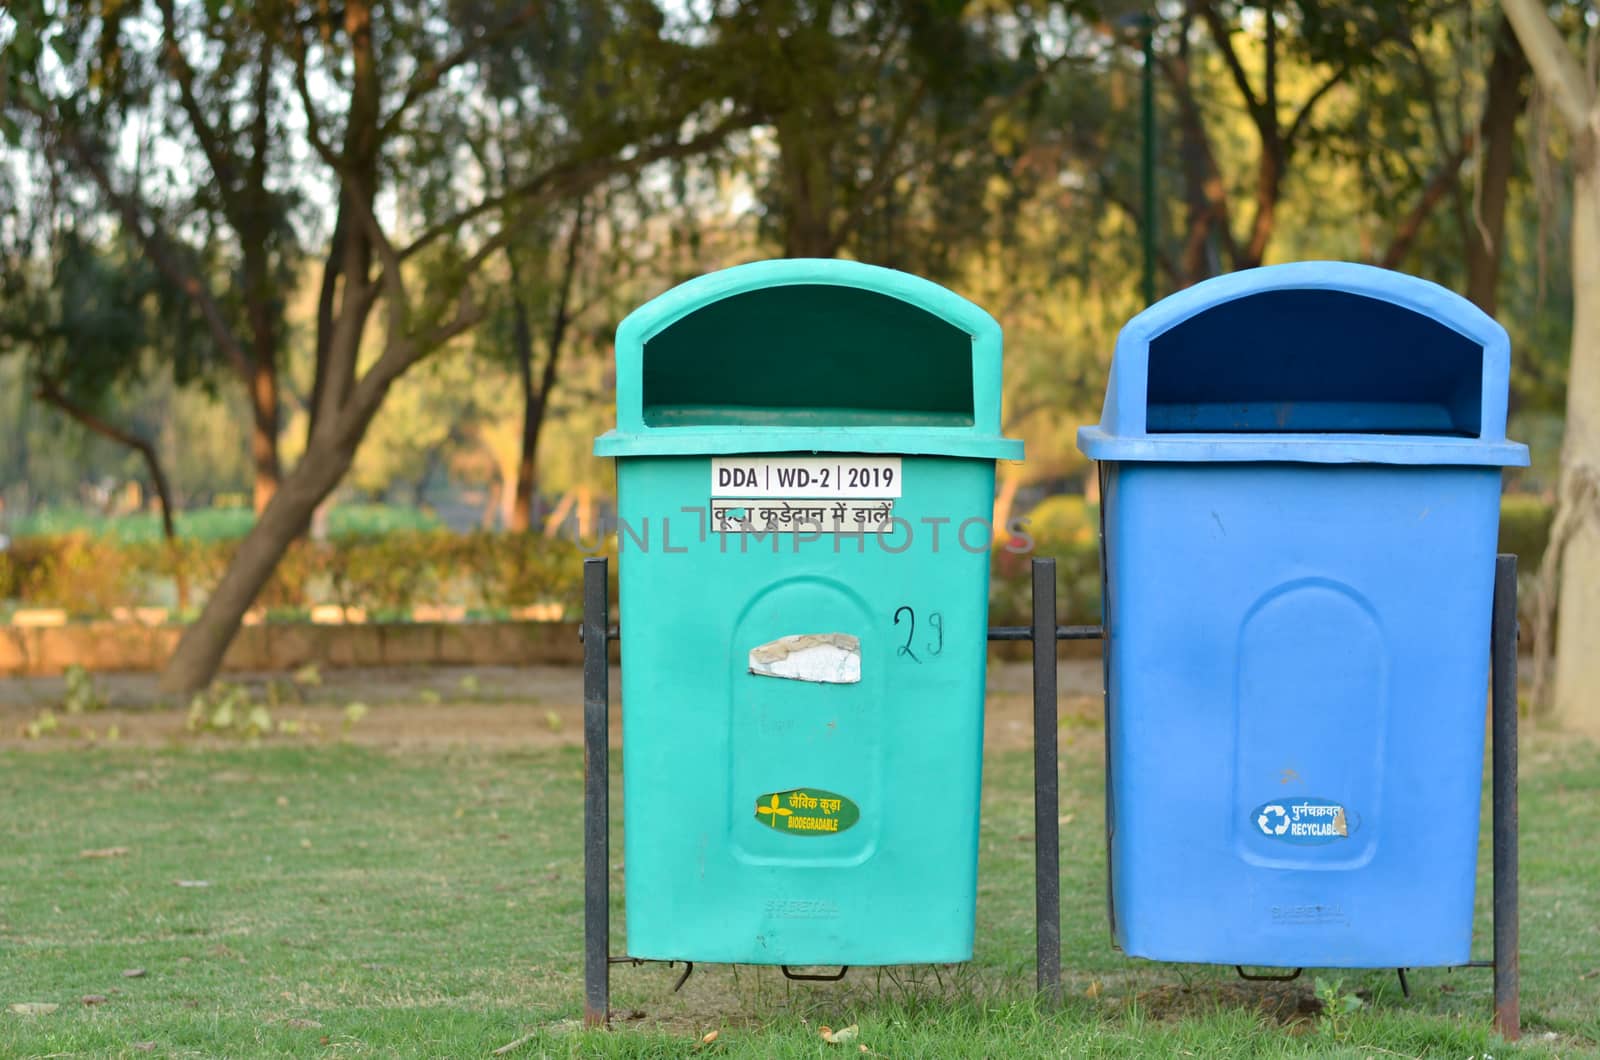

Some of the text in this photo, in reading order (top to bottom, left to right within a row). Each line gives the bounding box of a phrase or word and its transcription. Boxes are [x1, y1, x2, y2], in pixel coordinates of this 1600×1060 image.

[718, 467, 894, 488] DDA WD-2 2019
[831, 501, 848, 524] में
[852, 501, 893, 524] डालें
[893, 605, 943, 665] 29
[788, 791, 842, 815] जैविक कूड़ा
[787, 815, 839, 832] BIODEGRADABLE
